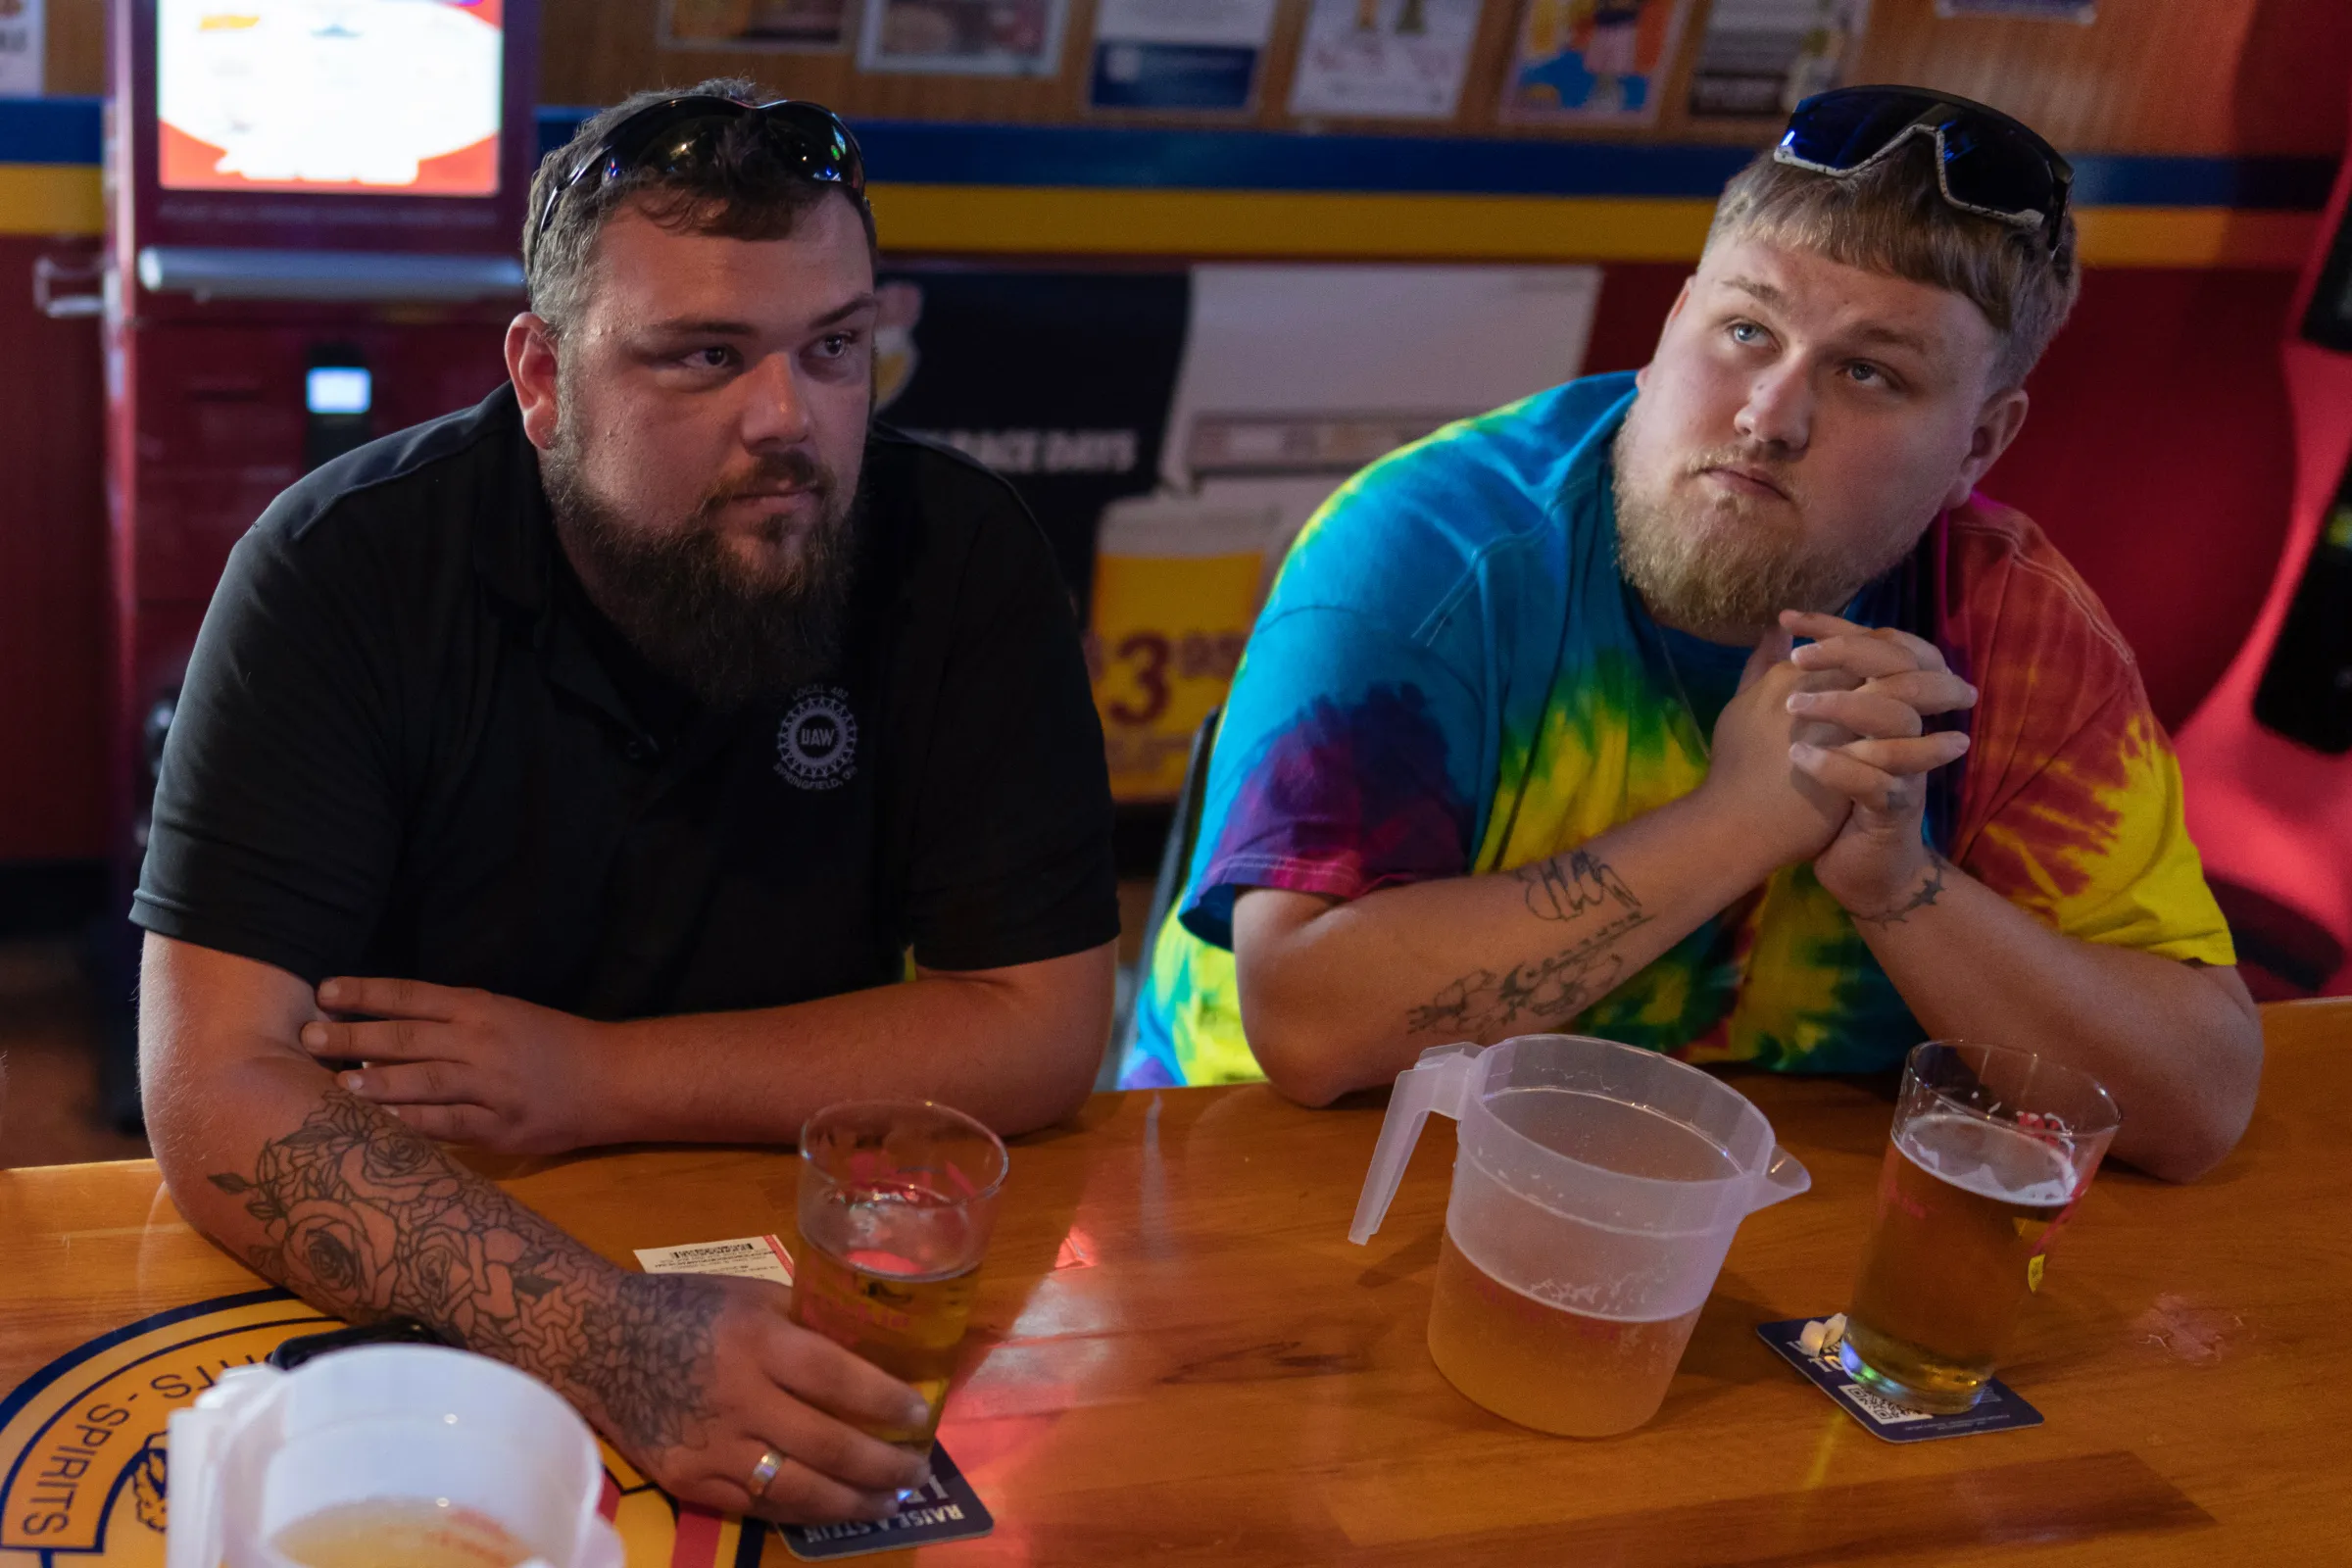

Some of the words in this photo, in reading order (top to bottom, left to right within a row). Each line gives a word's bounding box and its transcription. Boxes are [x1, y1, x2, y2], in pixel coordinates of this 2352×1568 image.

[800, 728, 835, 748] UAW
[22, 1403, 130, 1537] SPIRITS
[896, 1502, 965, 1529] RAISE
